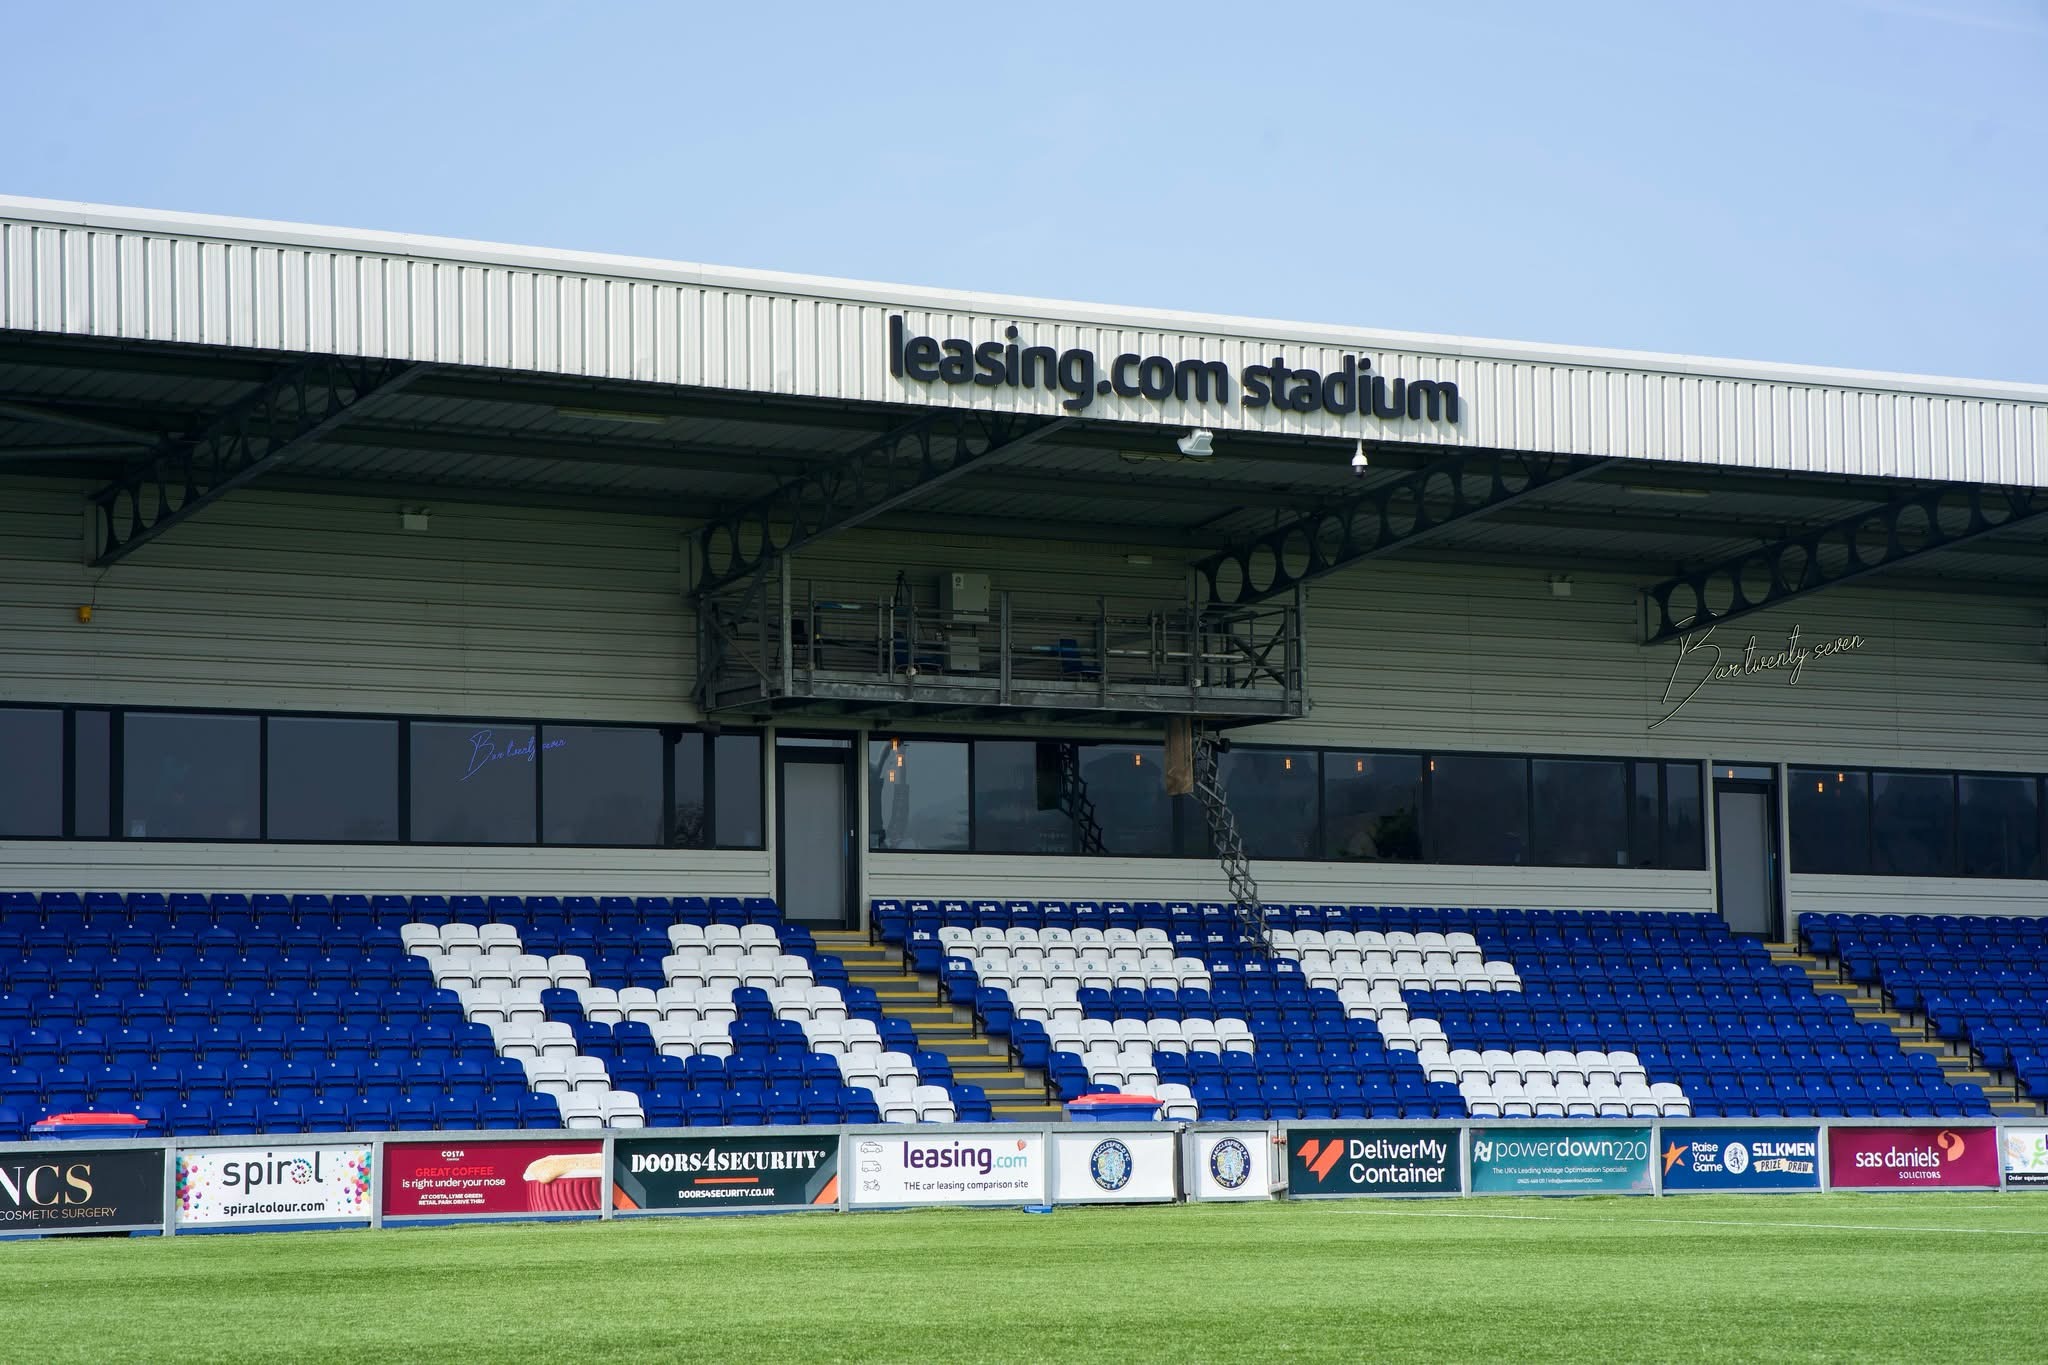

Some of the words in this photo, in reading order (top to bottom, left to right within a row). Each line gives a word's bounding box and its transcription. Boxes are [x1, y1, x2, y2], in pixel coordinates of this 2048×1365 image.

[889, 314, 1229, 411] leasing.com
[1240, 353, 1460, 424] stadium
[1648, 612, 1741, 730] Bar
[1743, 624, 1810, 685] twenty
[1813, 633, 1865, 661] seven
[1349, 1138, 1447, 1164] DeliverMy
[1495, 1136, 1648, 1163] powerdown220
[1691, 1142, 1719, 1152] Raise
[1752, 1142, 1815, 1157] SILKMEN
[441, 1150, 465, 1158] COSTA
[903, 1140, 1027, 1175] leasing.com
[1693, 1152, 1716, 1162] Your
[1855, 1150, 1883, 1168] sas
[1885, 1145, 1940, 1168] daniels
[415, 1167, 451, 1178] GREAT
[451, 1166, 495, 1177] COFFEE
[1517, 1166, 1541, 1176] Leading
[1541, 1166, 1564, 1176] Voltage
[1692, 1162, 1723, 1172] Game
[1760, 1159, 1781, 1171] PRIZE
[1787, 1162, 1809, 1172] DRAW
[1349, 1162, 1446, 1184] Container
[1898, 1171, 1942, 1180] SOLICITORS
[402, 1179, 410, 1188] is
[411, 1178, 434, 1190] right
[435, 1177, 461, 1188] under
[462, 1179, 483, 1189] your
[483, 1178, 506, 1187] nose
[904, 1181, 921, 1190] THE
[922, 1182, 935, 1190] car
[936, 1180, 965, 1192] leasing
[966, 1180, 1013, 1191] comparison
[1014, 1179, 1029, 1188] site
[678, 1187, 775, 1199] DOORS4SECURITY.CO.UK
[62, 1207, 117, 1219] SURGERY
[223, 1201, 326, 1217] spiralcolour.com
